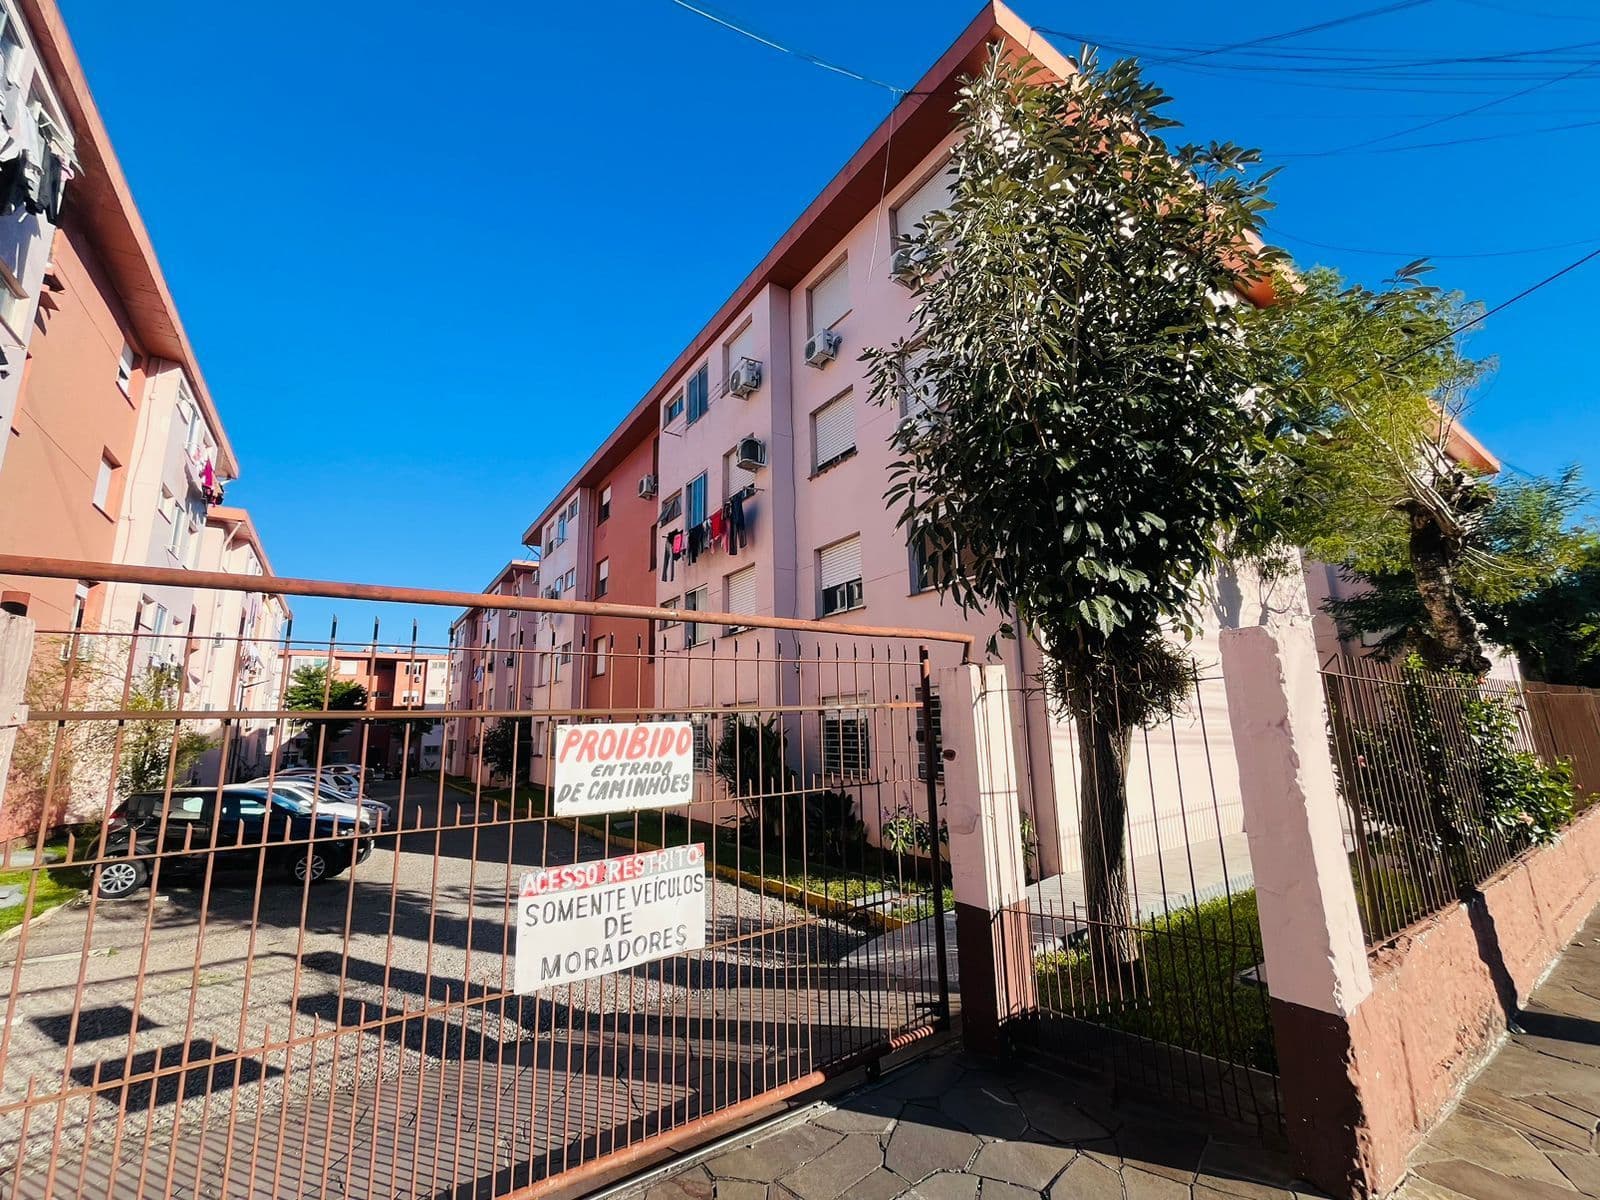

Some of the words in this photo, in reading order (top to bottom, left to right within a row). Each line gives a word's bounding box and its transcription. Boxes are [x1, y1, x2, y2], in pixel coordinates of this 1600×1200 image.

[559, 726, 692, 763] PROIBIDO
[591, 761, 673, 777] ENTRADA
[557, 782, 584, 803] DE
[520, 862, 599, 897] ACESSO
[608, 846, 700, 882] RESTRITO
[525, 887, 626, 927] SOMENTE
[632, 873, 704, 907] VEÍCULOS
[604, 912, 633, 939] DE
[540, 924, 688, 981] MORADORES
